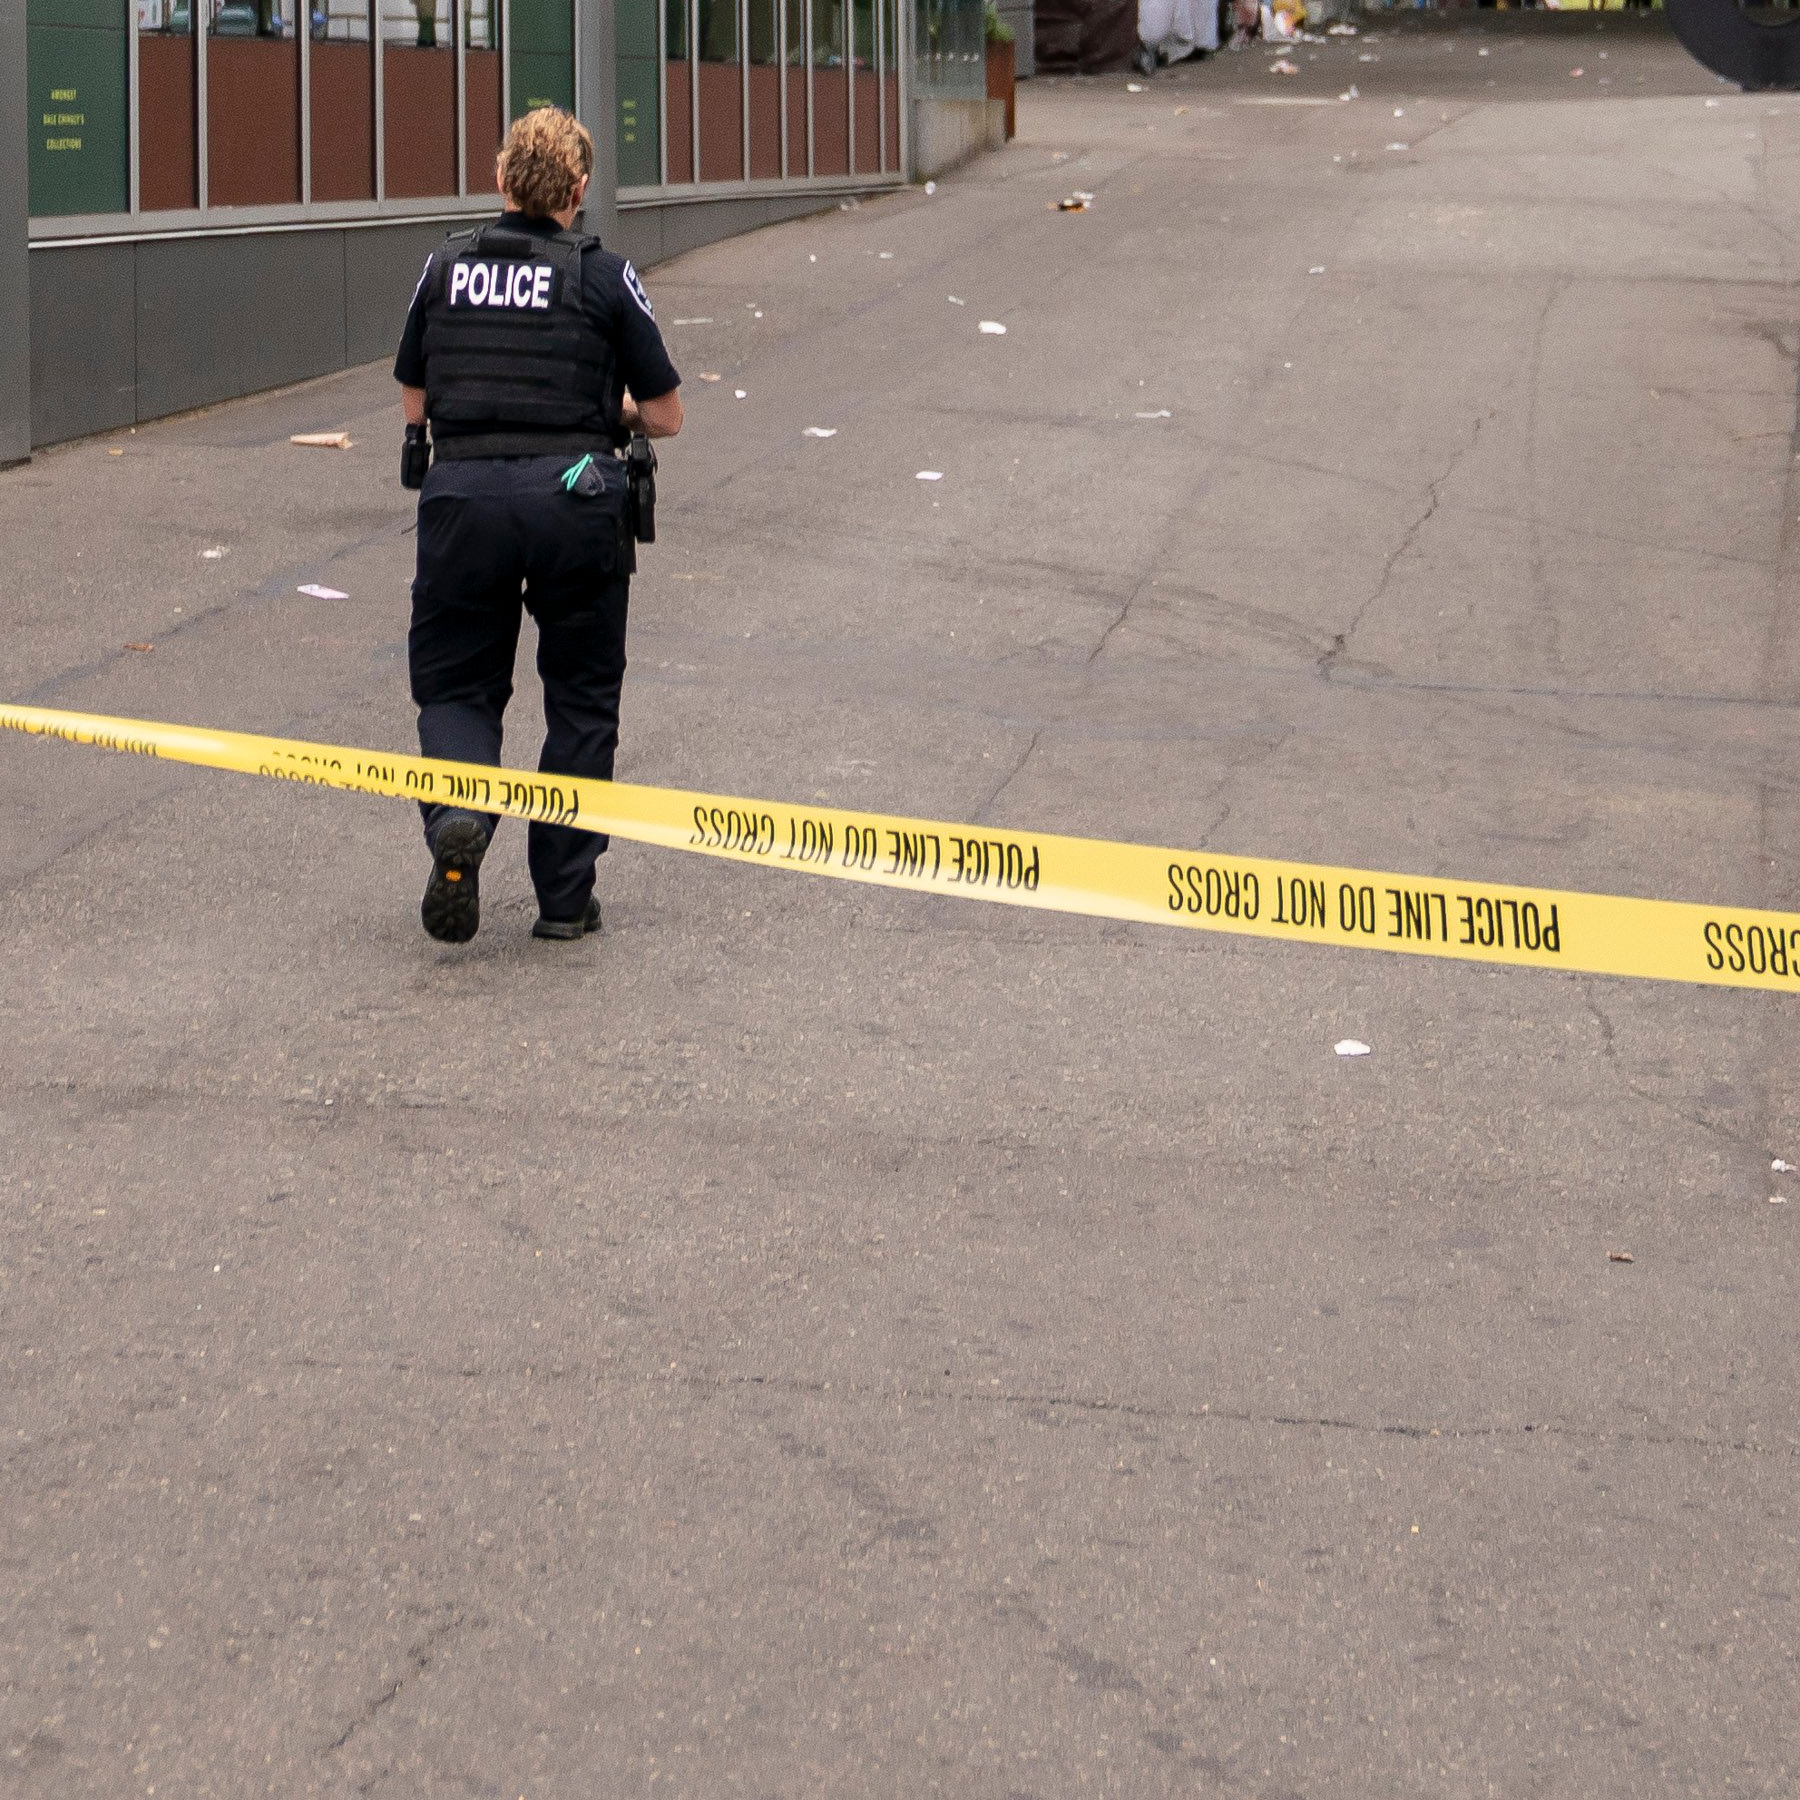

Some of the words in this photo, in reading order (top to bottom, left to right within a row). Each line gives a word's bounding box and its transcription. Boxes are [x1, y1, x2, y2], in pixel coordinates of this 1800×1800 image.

[450, 262, 553, 309] POLICE
[498, 780, 580, 825] POLICE
[689, 806, 775, 848] CROSS
[781, 817, 835, 864] NOT
[845, 825, 879, 870] DO
[883, 830, 941, 881] LINE
[949, 838, 1041, 891] POLICE
[1168, 864, 1260, 920] CROSS
[1271, 876, 1326, 928] NOT
[1339, 884, 1374, 934] DO
[1385, 889, 1448, 943] LINE
[1456, 896, 1561, 953] POLICE
